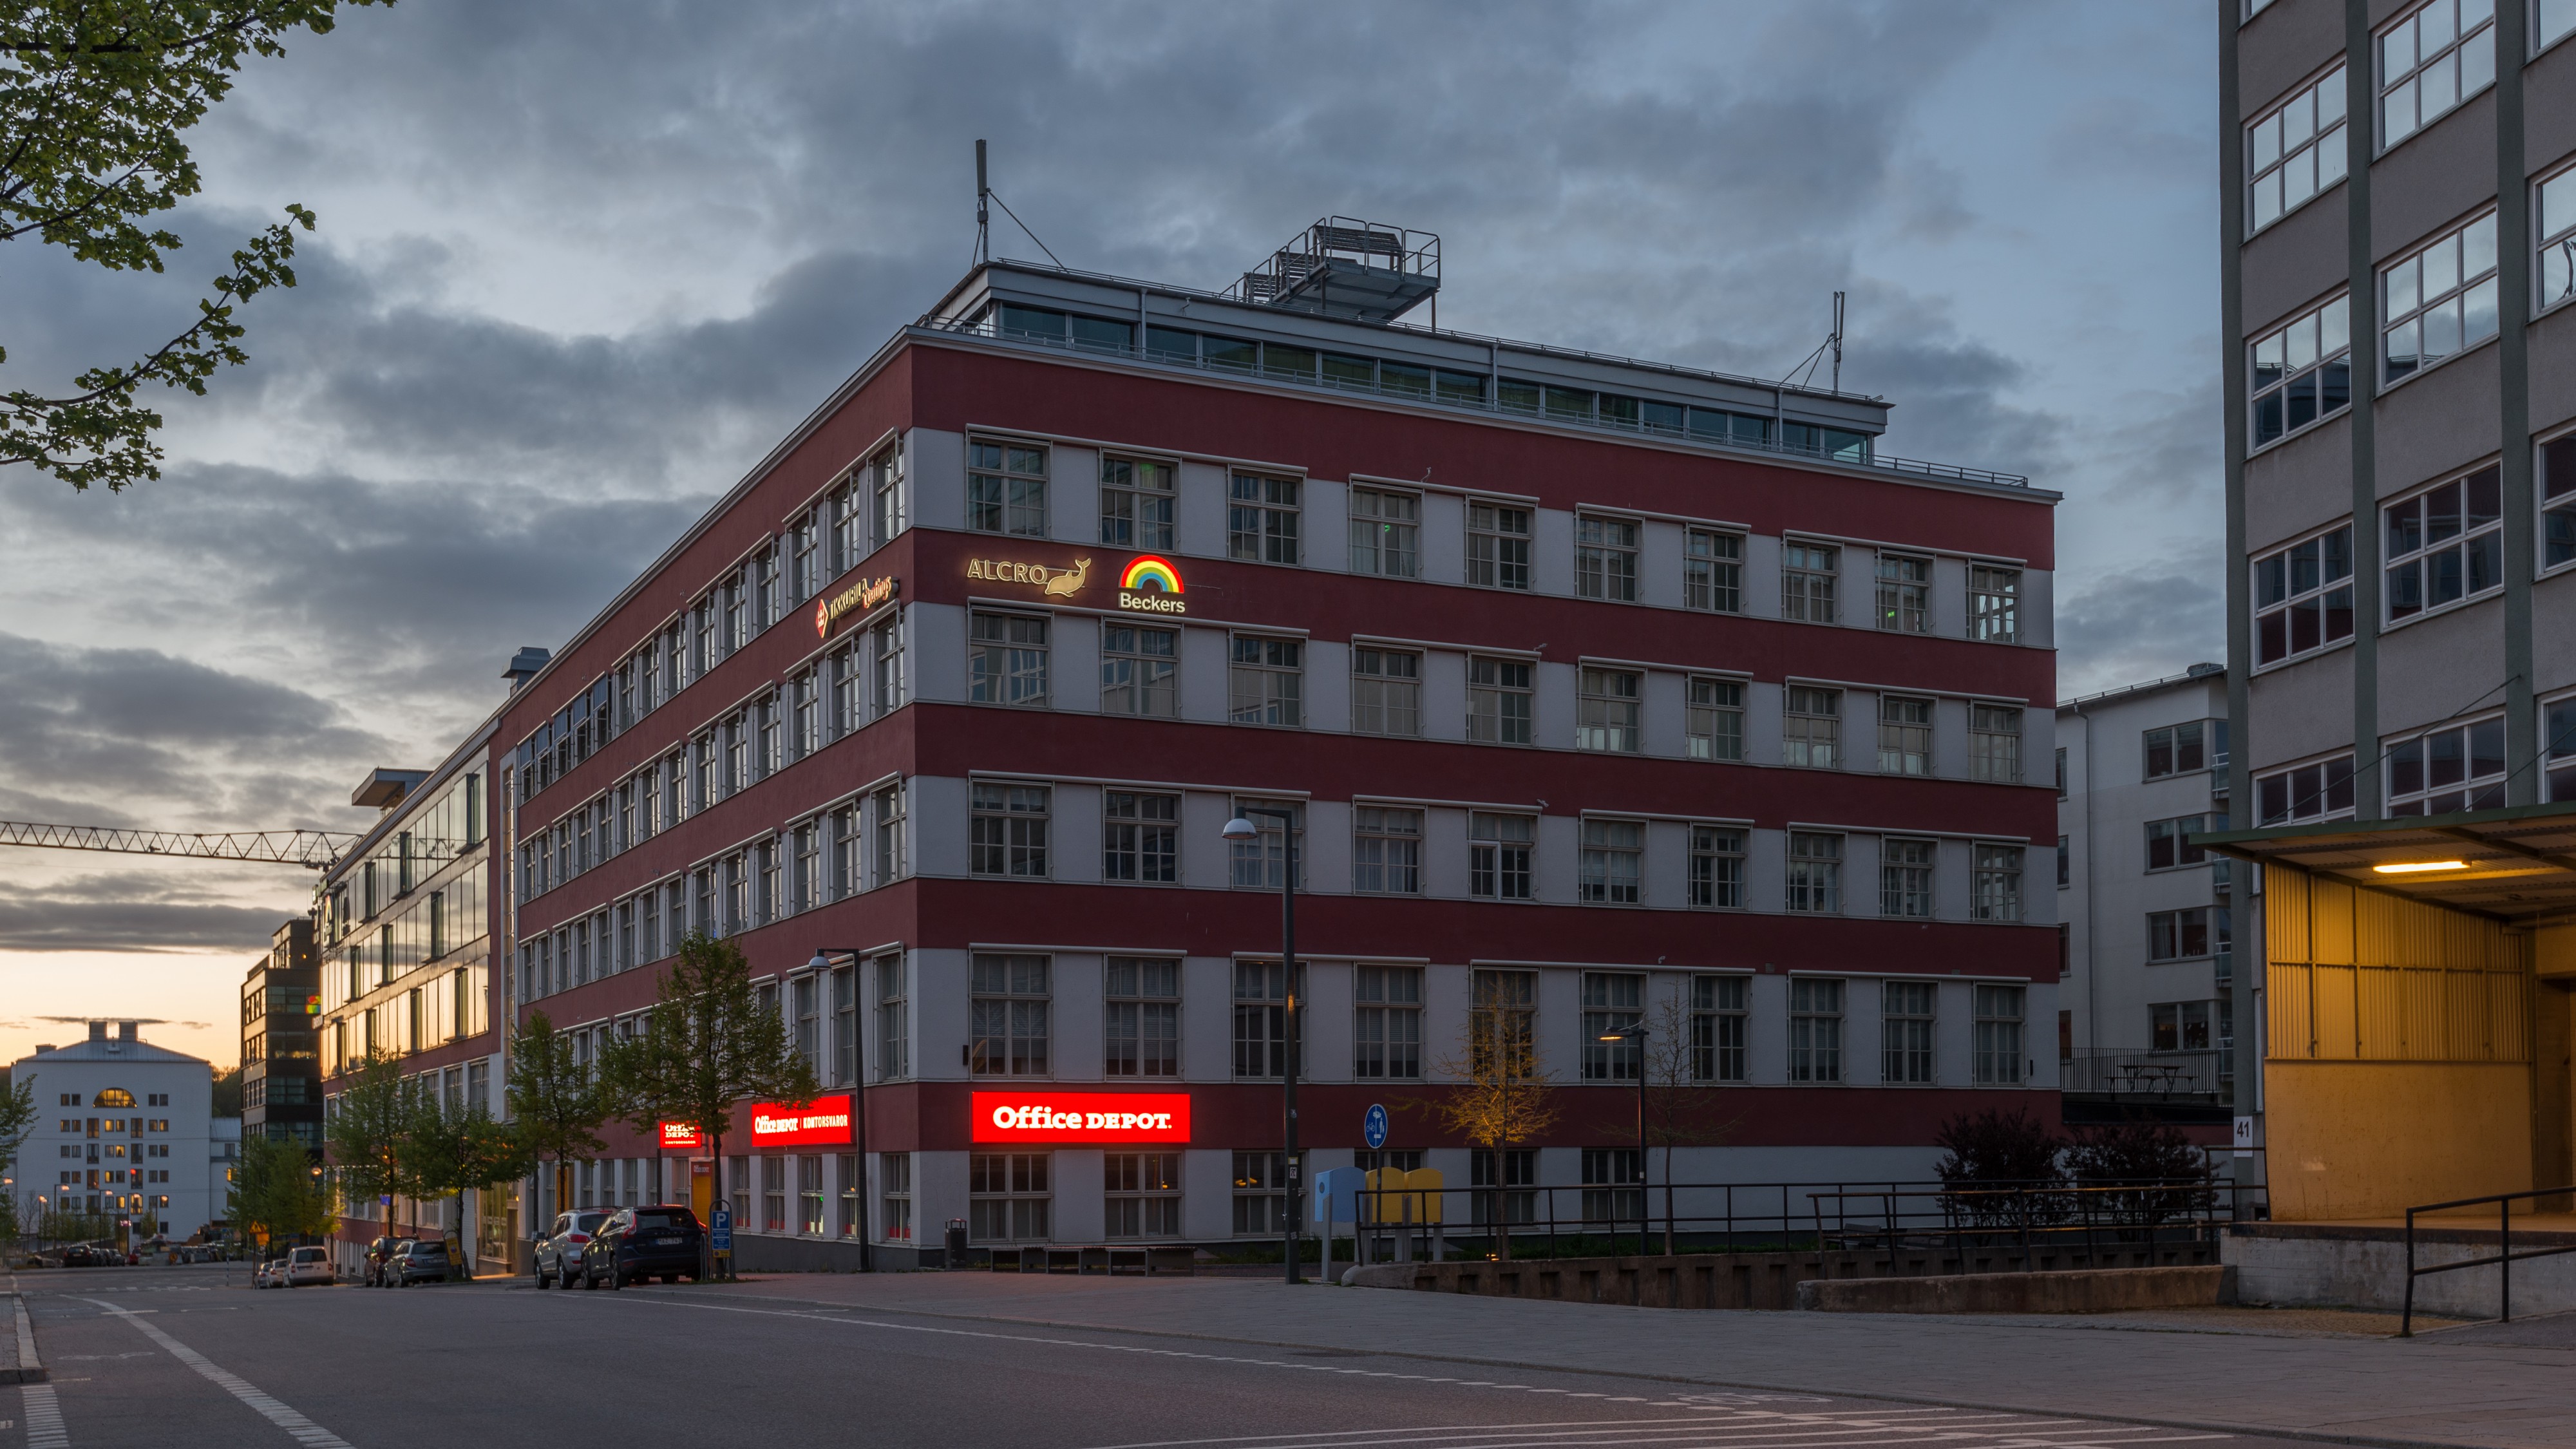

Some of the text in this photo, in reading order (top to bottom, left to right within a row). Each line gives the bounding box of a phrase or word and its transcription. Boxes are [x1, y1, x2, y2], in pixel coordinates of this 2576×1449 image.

[967, 558, 1048, 585] ALCRO
[829, 576, 892, 620] TIKKURILA Coatings
[1119, 592, 1186, 613] Beckers
[755, 1115, 777, 1134] Office
[803, 1115, 848, 1129] KONTORSVAROR
[992, 1106, 1083, 1129] Office
[2237, 1121, 2249, 1138] 41
[716, 1213, 727, 1227] P
